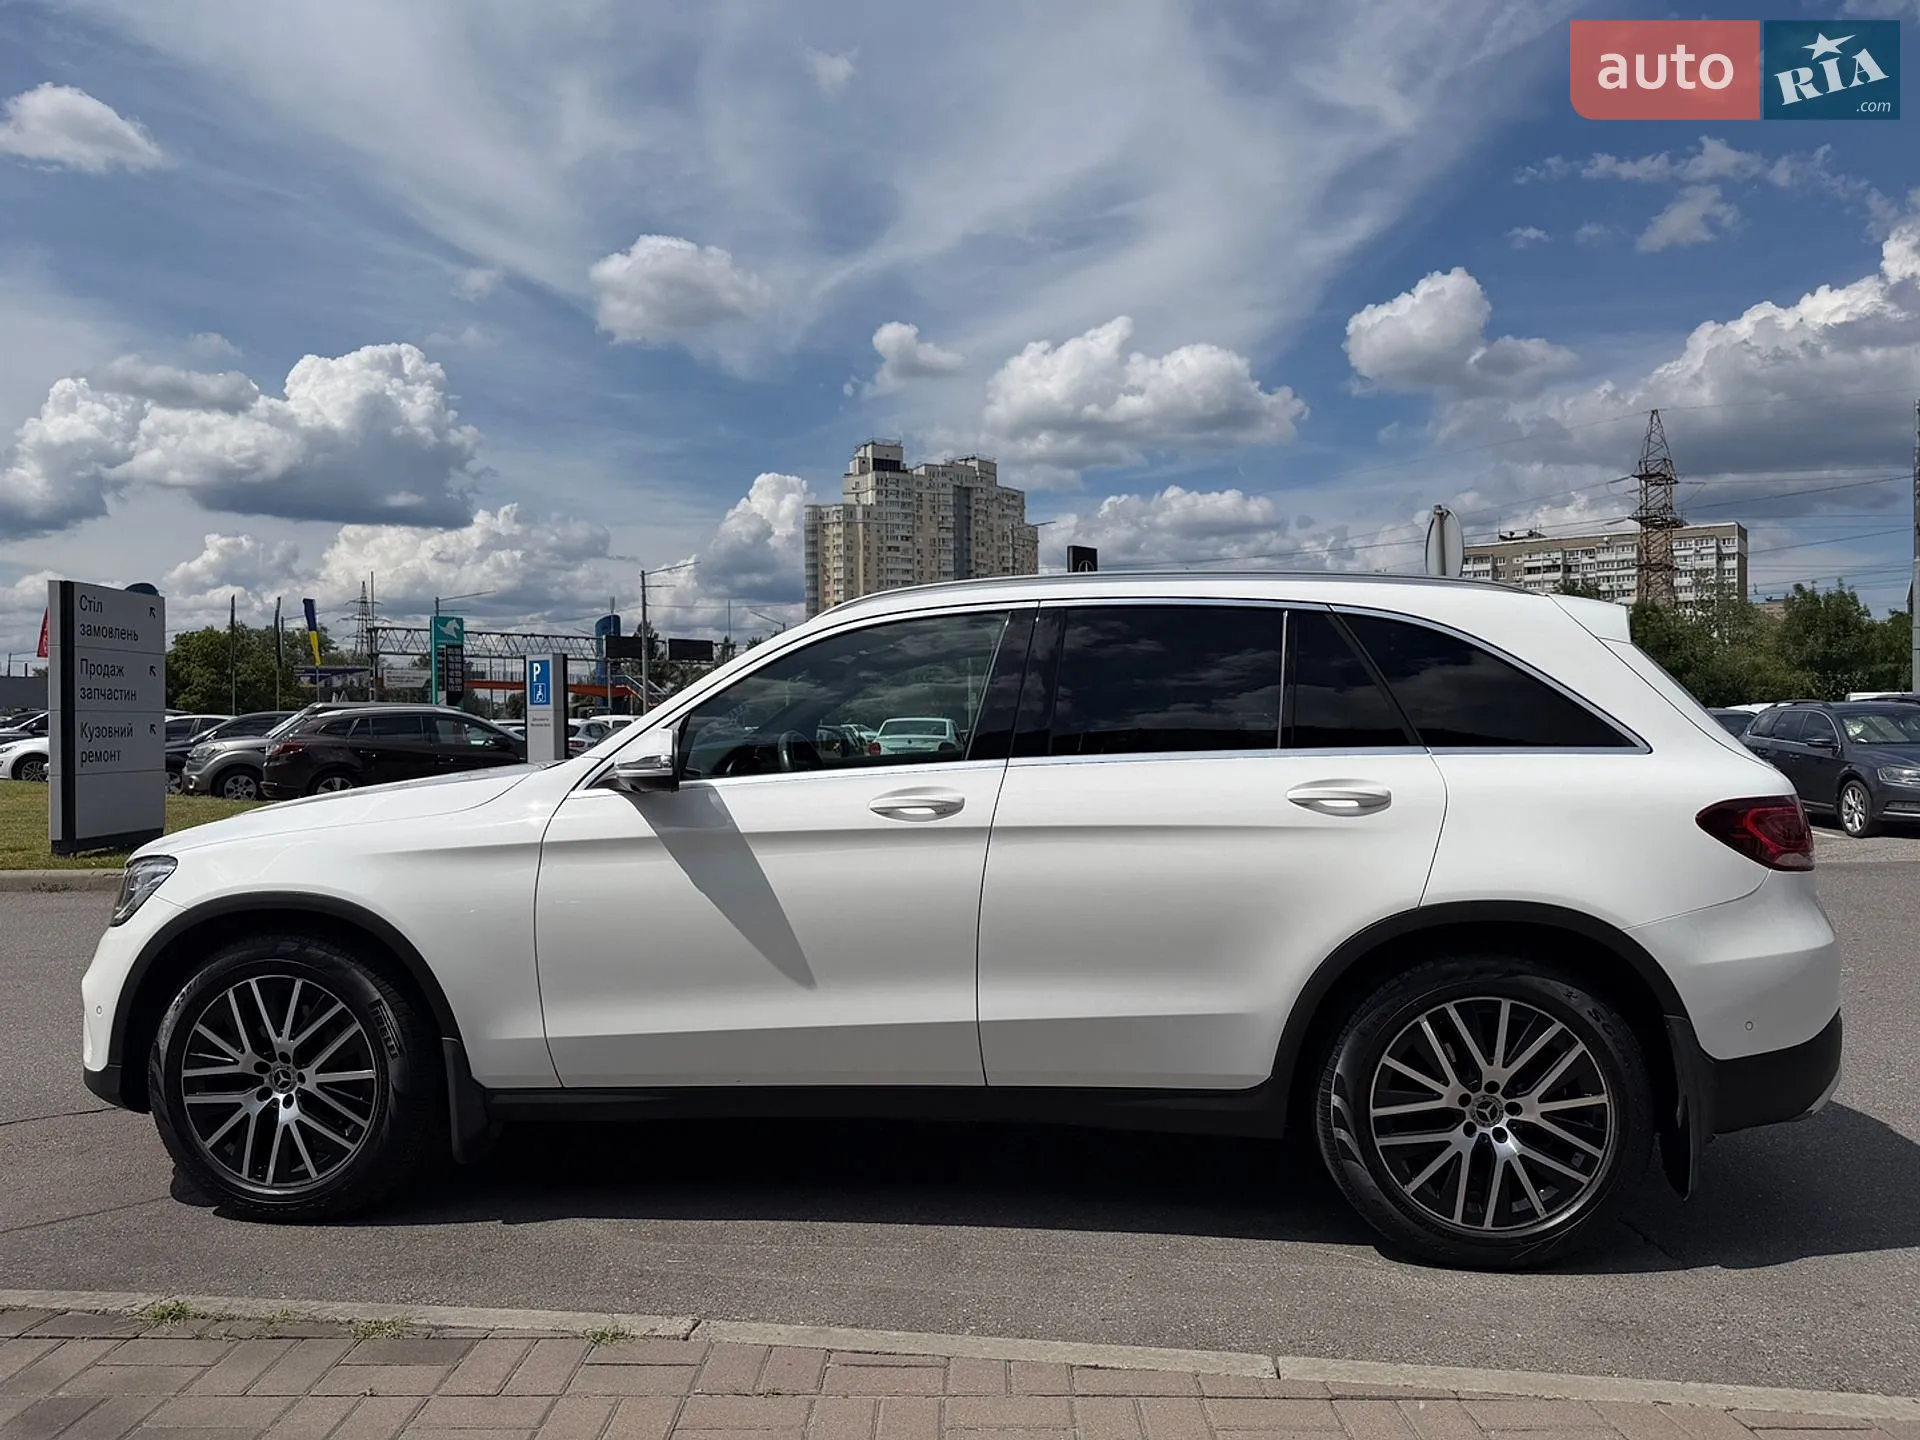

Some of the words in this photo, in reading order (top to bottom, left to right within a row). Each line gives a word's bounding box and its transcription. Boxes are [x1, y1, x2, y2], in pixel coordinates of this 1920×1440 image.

[79, 594, 103, 614] Стіл
[79, 623, 139, 642] замовлень
[79, 658, 125, 679] Продаж
[533, 662, 542, 682] P
[79, 687, 137, 702] запчастин
[79, 721, 134, 743] Кузовний
[80, 749, 121, 767] ремонт
